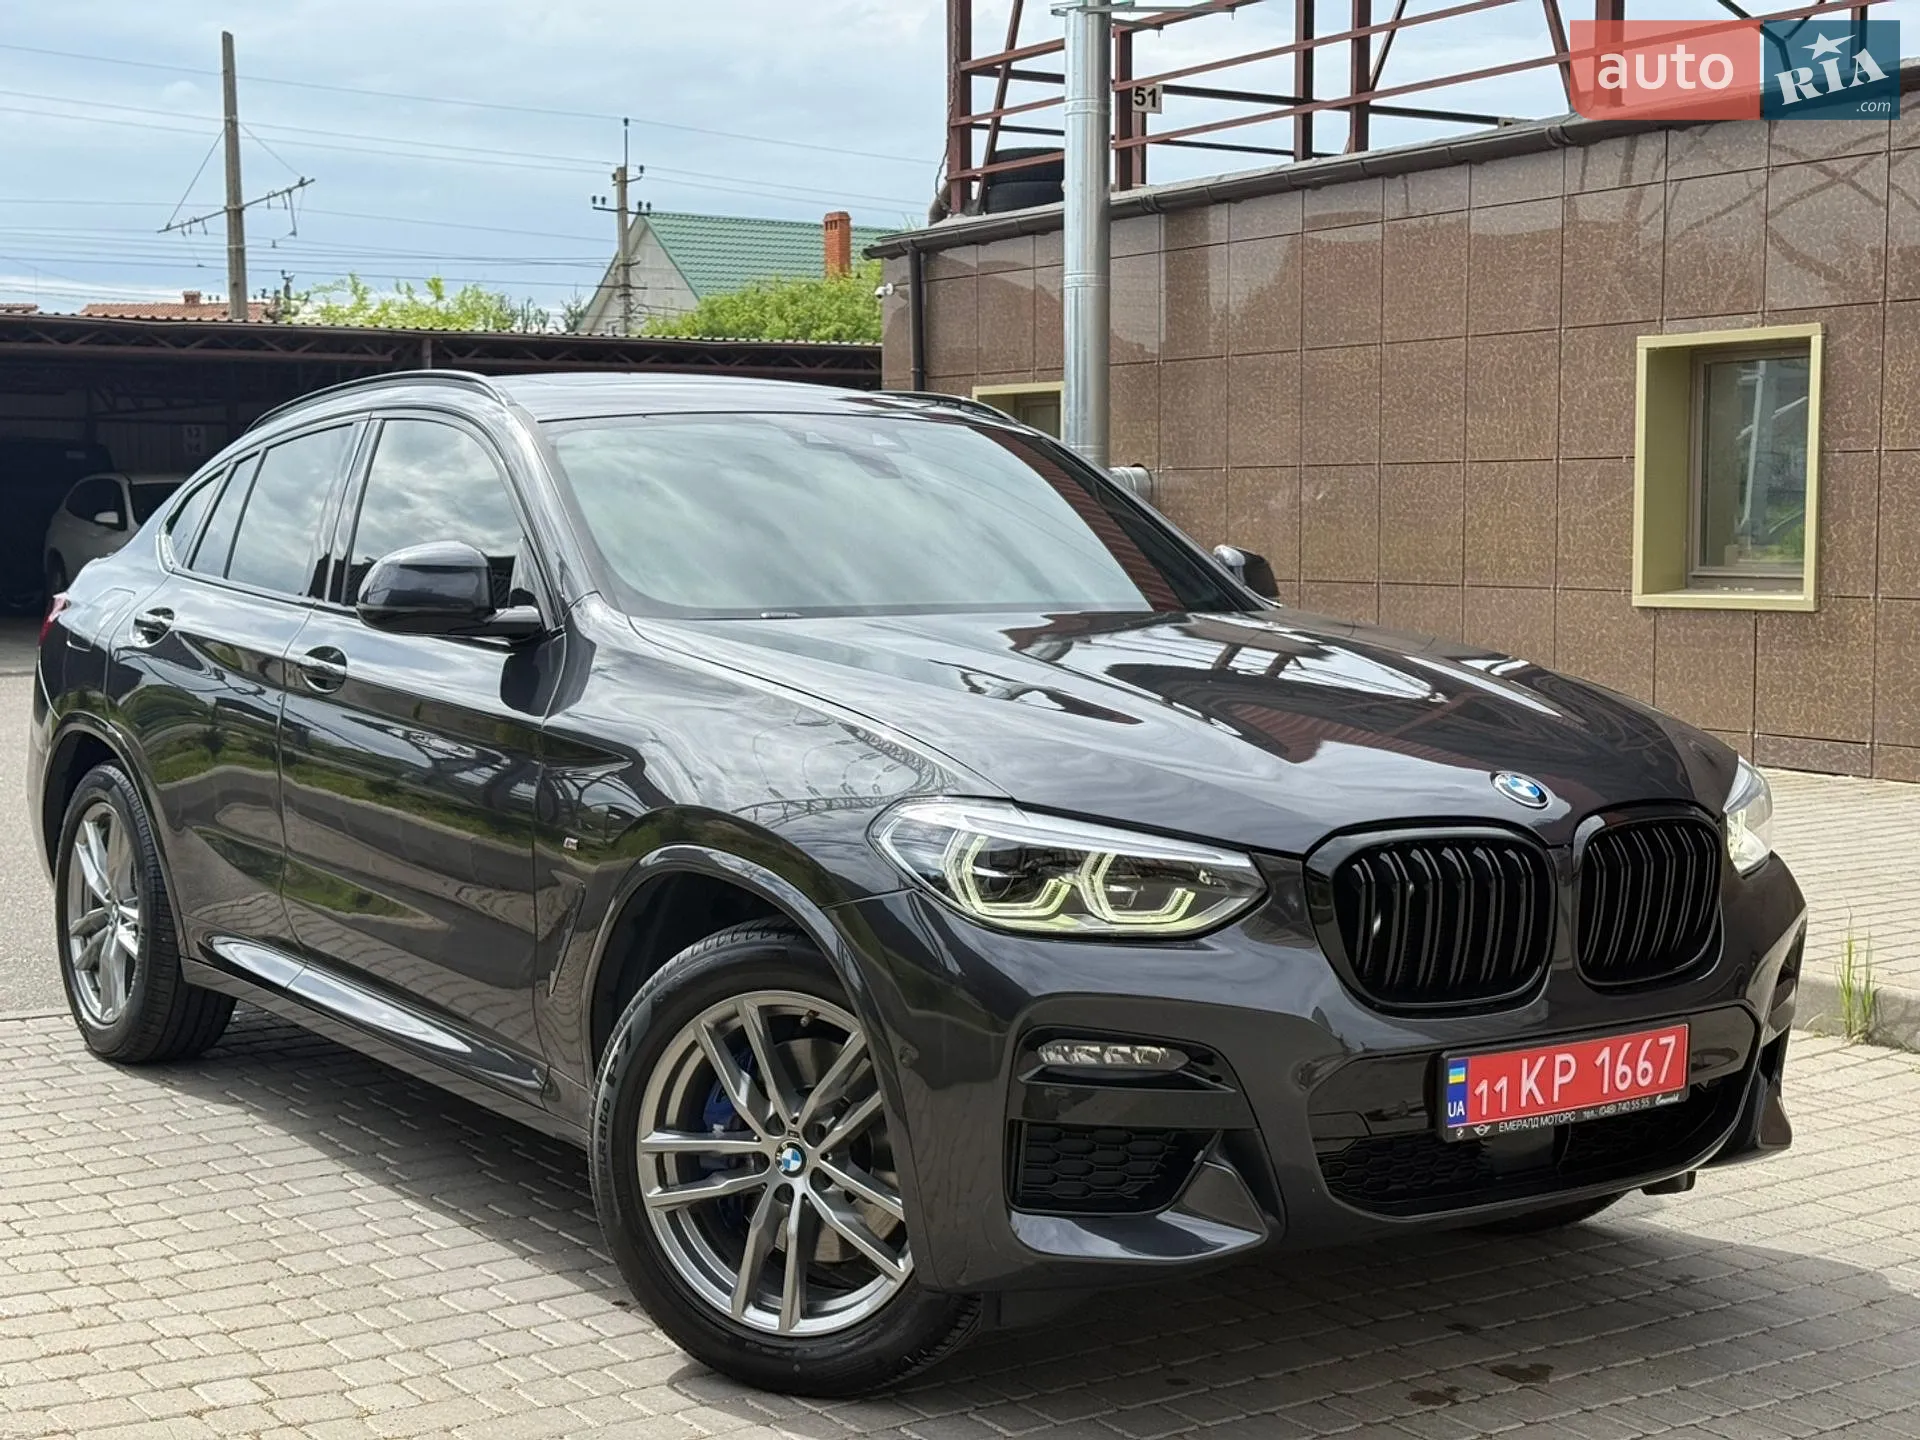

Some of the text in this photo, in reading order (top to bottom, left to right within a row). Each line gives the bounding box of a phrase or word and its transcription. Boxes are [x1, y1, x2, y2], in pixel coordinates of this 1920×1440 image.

[1134, 86, 1157, 108] 51
[1474, 1035, 1676, 1116] 11 KP 1667
[1447, 1100, 1465, 1117] UA
[1498, 1117, 1539, 1132] ЕМЕРАЛД
[1540, 1111, 1576, 1127] МОТОРС
